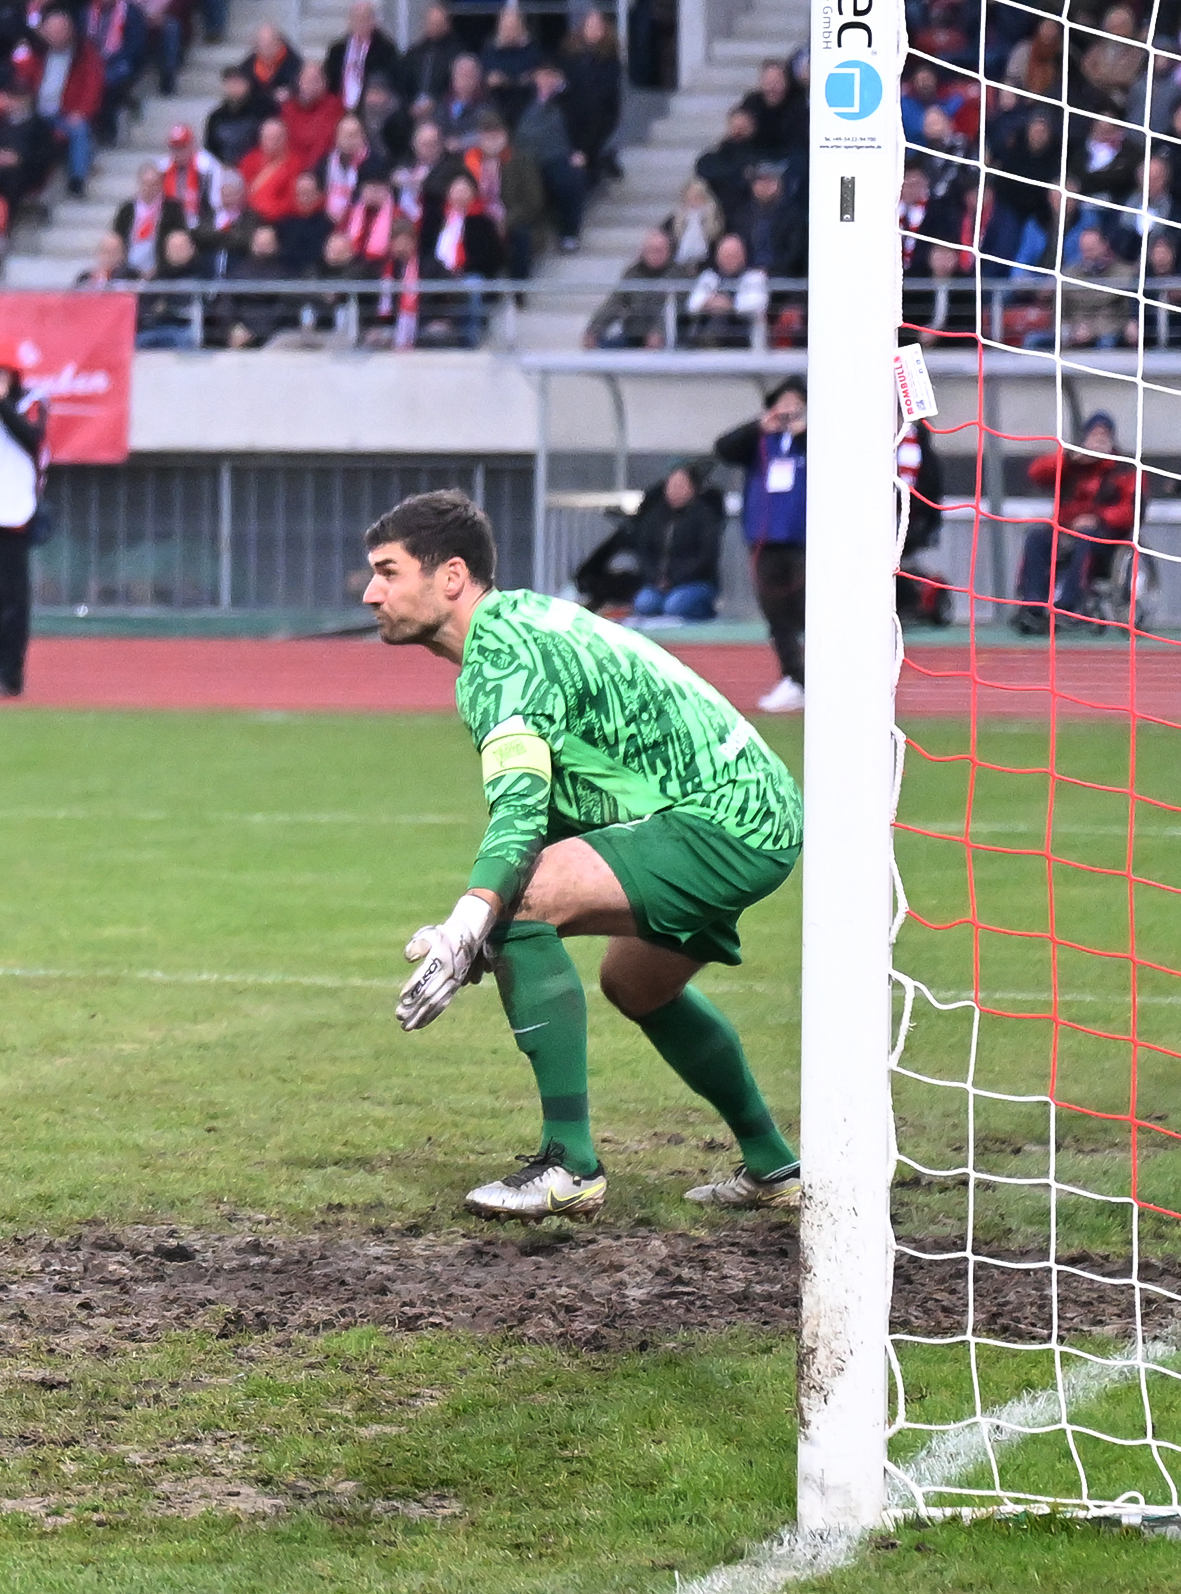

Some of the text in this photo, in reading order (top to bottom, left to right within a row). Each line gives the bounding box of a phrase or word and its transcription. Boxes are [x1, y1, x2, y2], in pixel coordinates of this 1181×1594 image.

[822, 5, 833, 50] GmbH
[895, 364, 915, 416] ROMBULL
[411, 957, 443, 999] reusch
